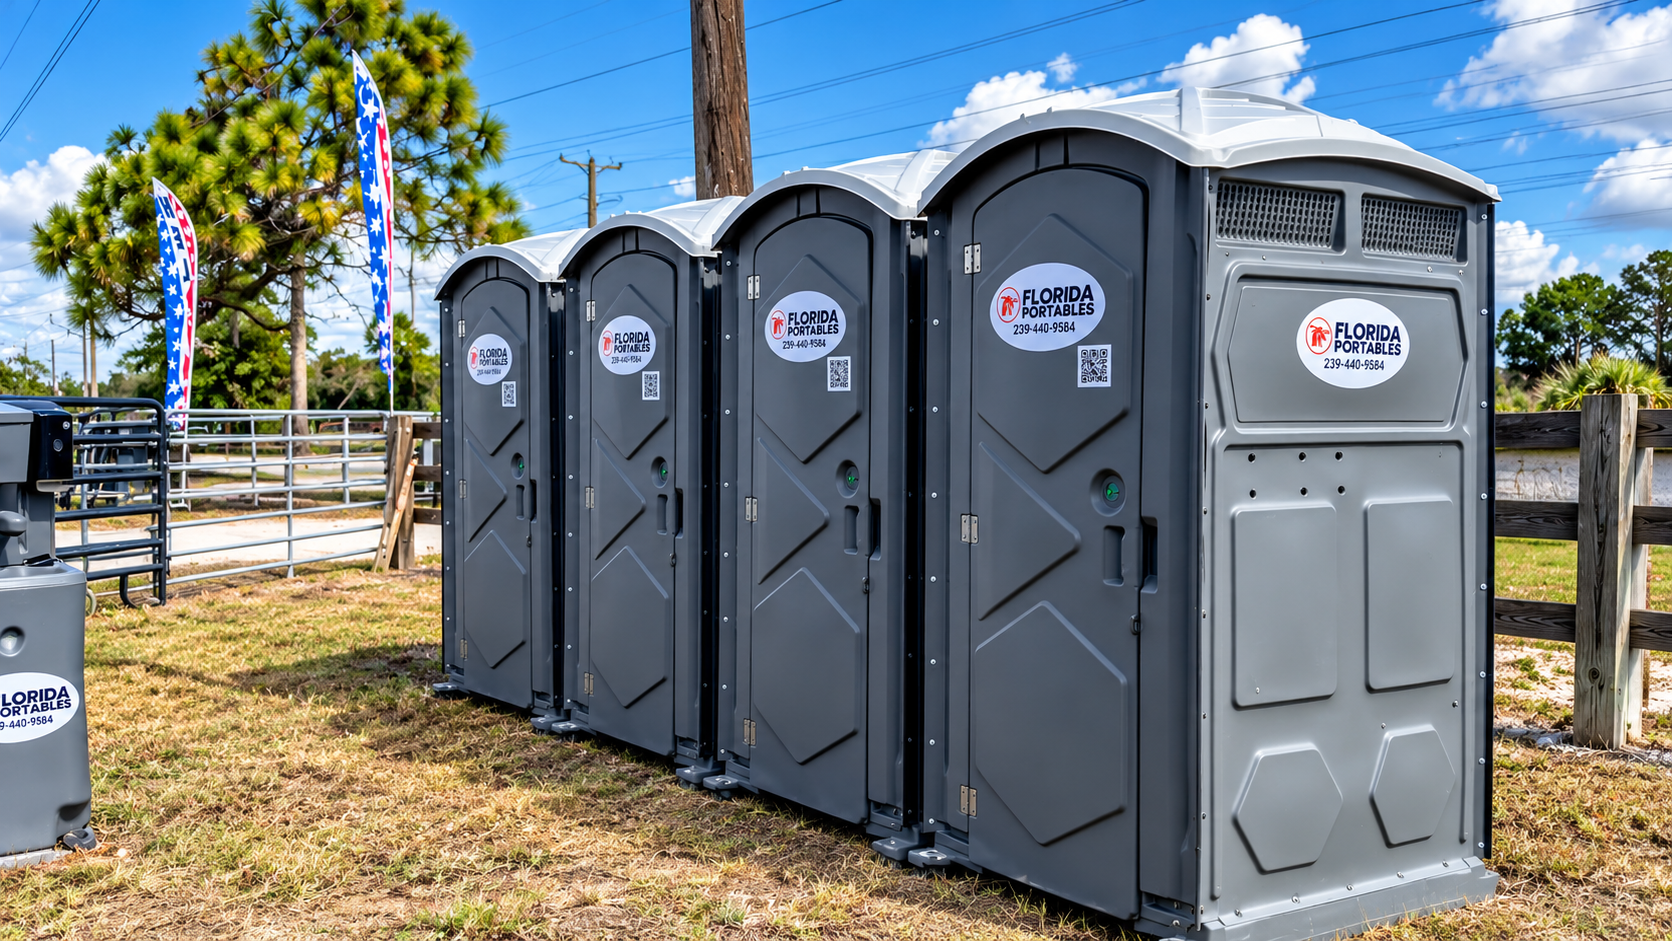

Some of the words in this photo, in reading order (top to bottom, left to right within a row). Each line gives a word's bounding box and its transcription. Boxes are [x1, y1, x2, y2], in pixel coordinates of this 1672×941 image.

[1022, 284, 1094, 306] FLORIDA
[787, 309, 839, 326] FLORIDA
[1022, 302, 1095, 319] PORTABLES
[787, 324, 839, 336] PORTABLES
[1013, 321, 1076, 335] 239-440-9584
[1335, 321, 1401, 343] FLORIDA
[614, 331, 650, 344] FLORIDA
[1334, 340, 1402, 356] PORTABLES
[1323, 357, 1385, 371] 239-440-9584
[0, 686, 70, 707] LORIDA
[0, 698, 72, 718] ORTABLES
[0, 714, 53, 731] 9-440-9584
